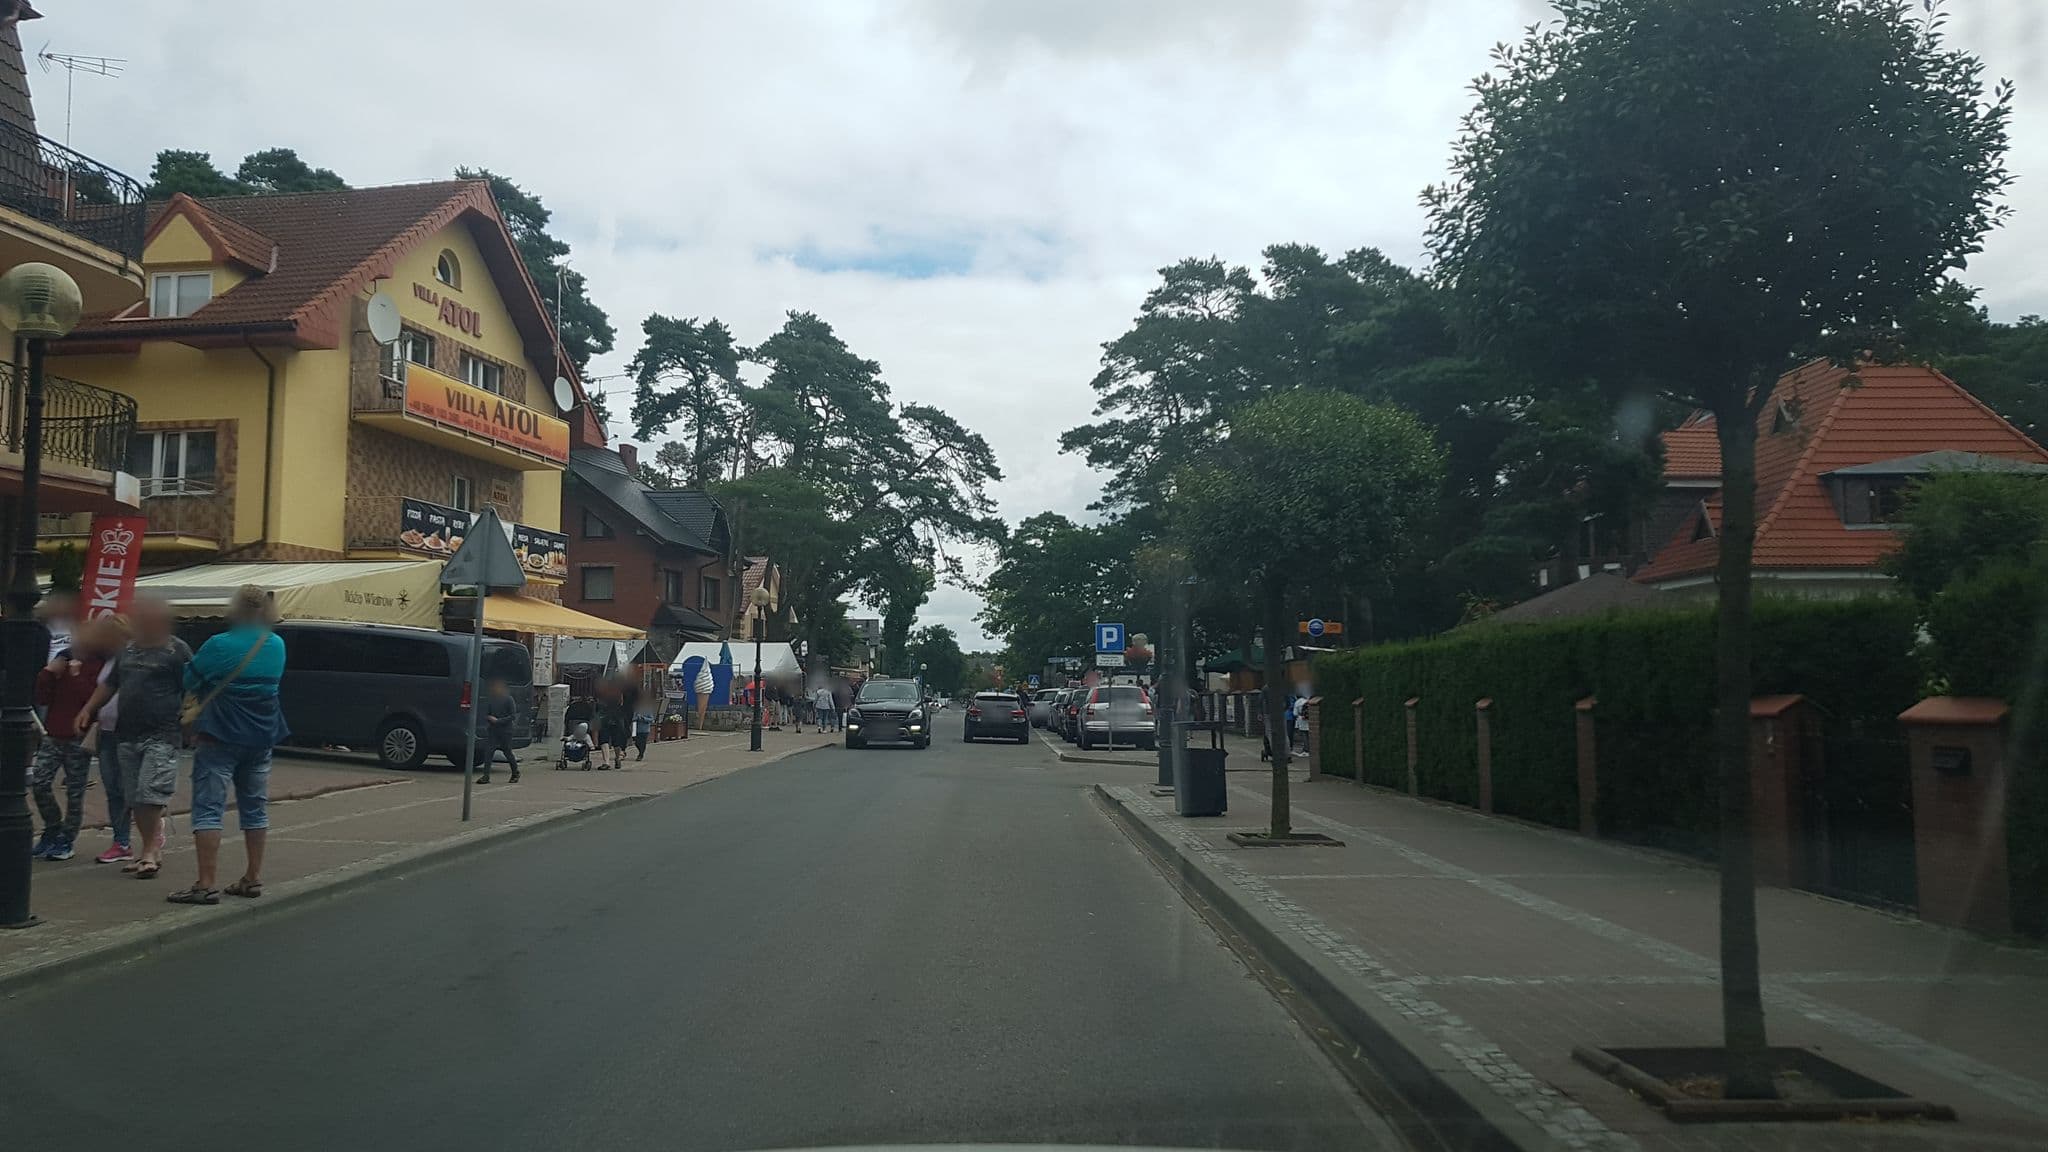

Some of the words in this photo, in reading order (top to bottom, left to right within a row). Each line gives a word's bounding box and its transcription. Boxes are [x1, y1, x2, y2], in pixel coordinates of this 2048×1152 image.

[413, 282, 438, 307] VILLA
[439, 297, 482, 338] ATOL
[445, 387, 488, 421] VILLA
[492, 399, 542, 441] ATOL
[1102, 627, 1118, 649] P
